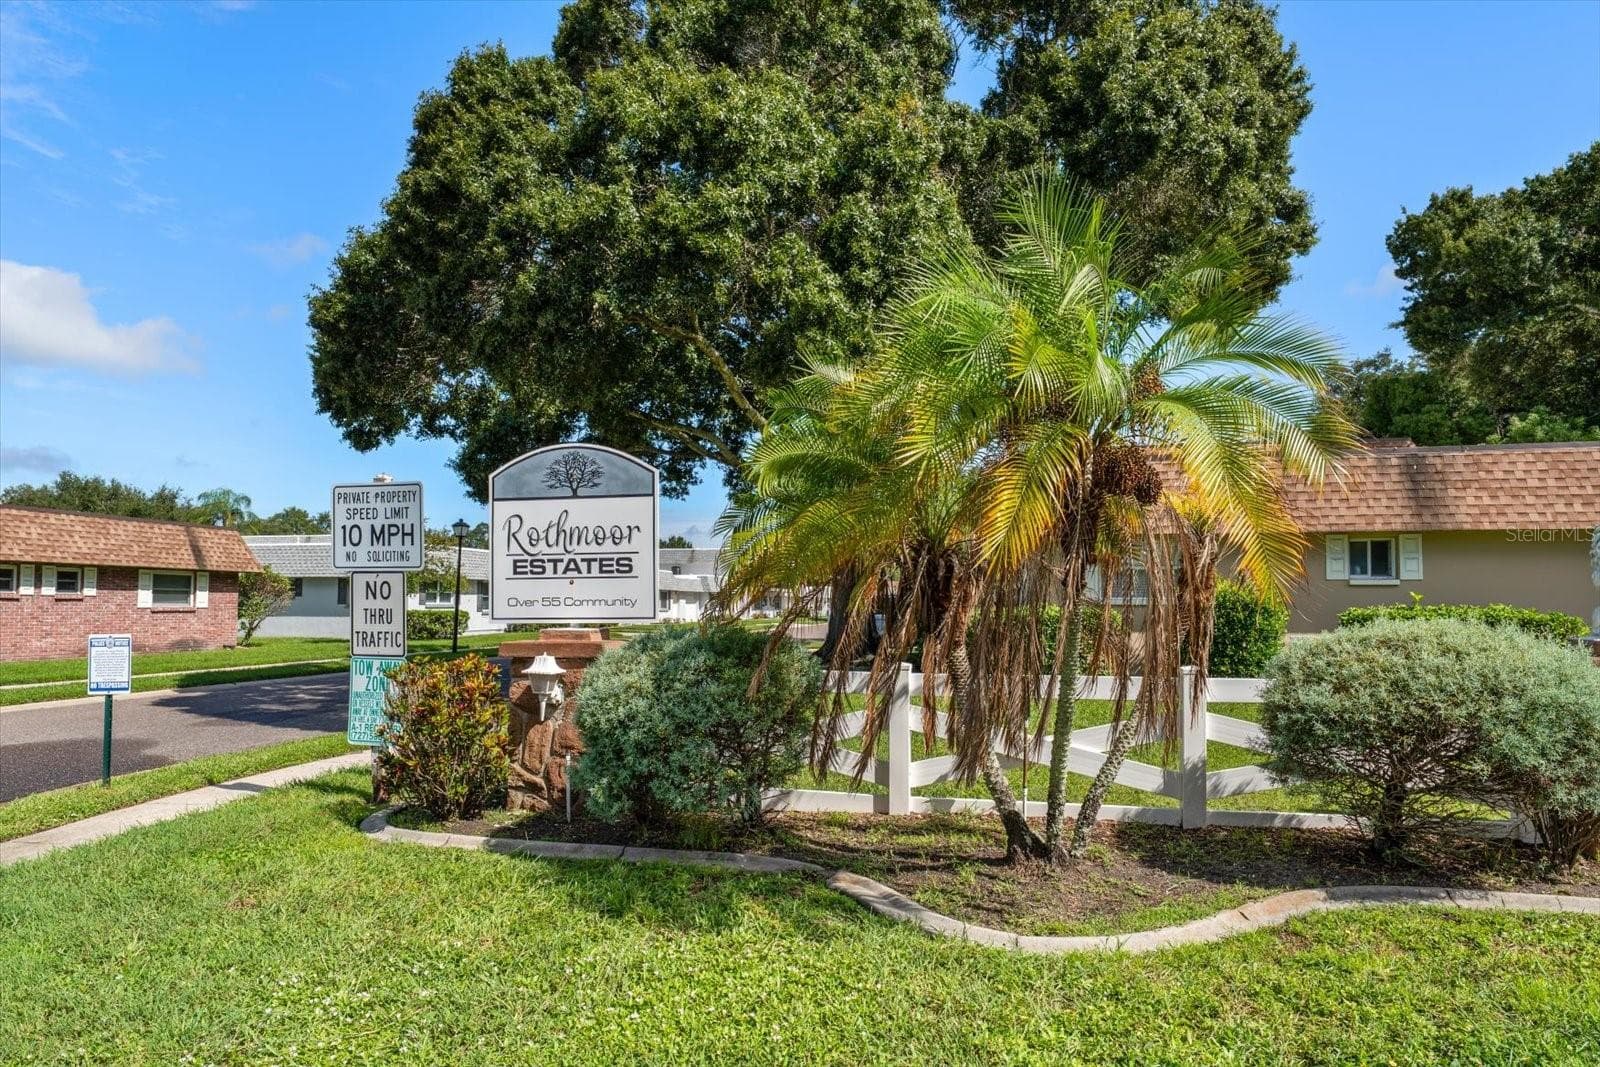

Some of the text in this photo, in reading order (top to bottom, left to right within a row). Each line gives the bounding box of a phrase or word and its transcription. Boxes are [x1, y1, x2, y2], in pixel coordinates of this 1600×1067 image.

[337, 490, 417, 504] PRIVATE PROPERTY
[346, 507, 409, 520] SPEED LIMIT
[341, 523, 414, 546] 10 MPH
[502, 510, 641, 556] Rothmoor
[346, 550, 410, 562] NO SOLICITING
[512, 557, 633, 575] ESTATES
[365, 580, 391, 600] NO
[508, 596, 637, 609] Over 55 Community
[363, 608, 392, 625] THRU
[355, 631, 401, 648] TRAFFIC
[354, 660, 374, 675] TOW
